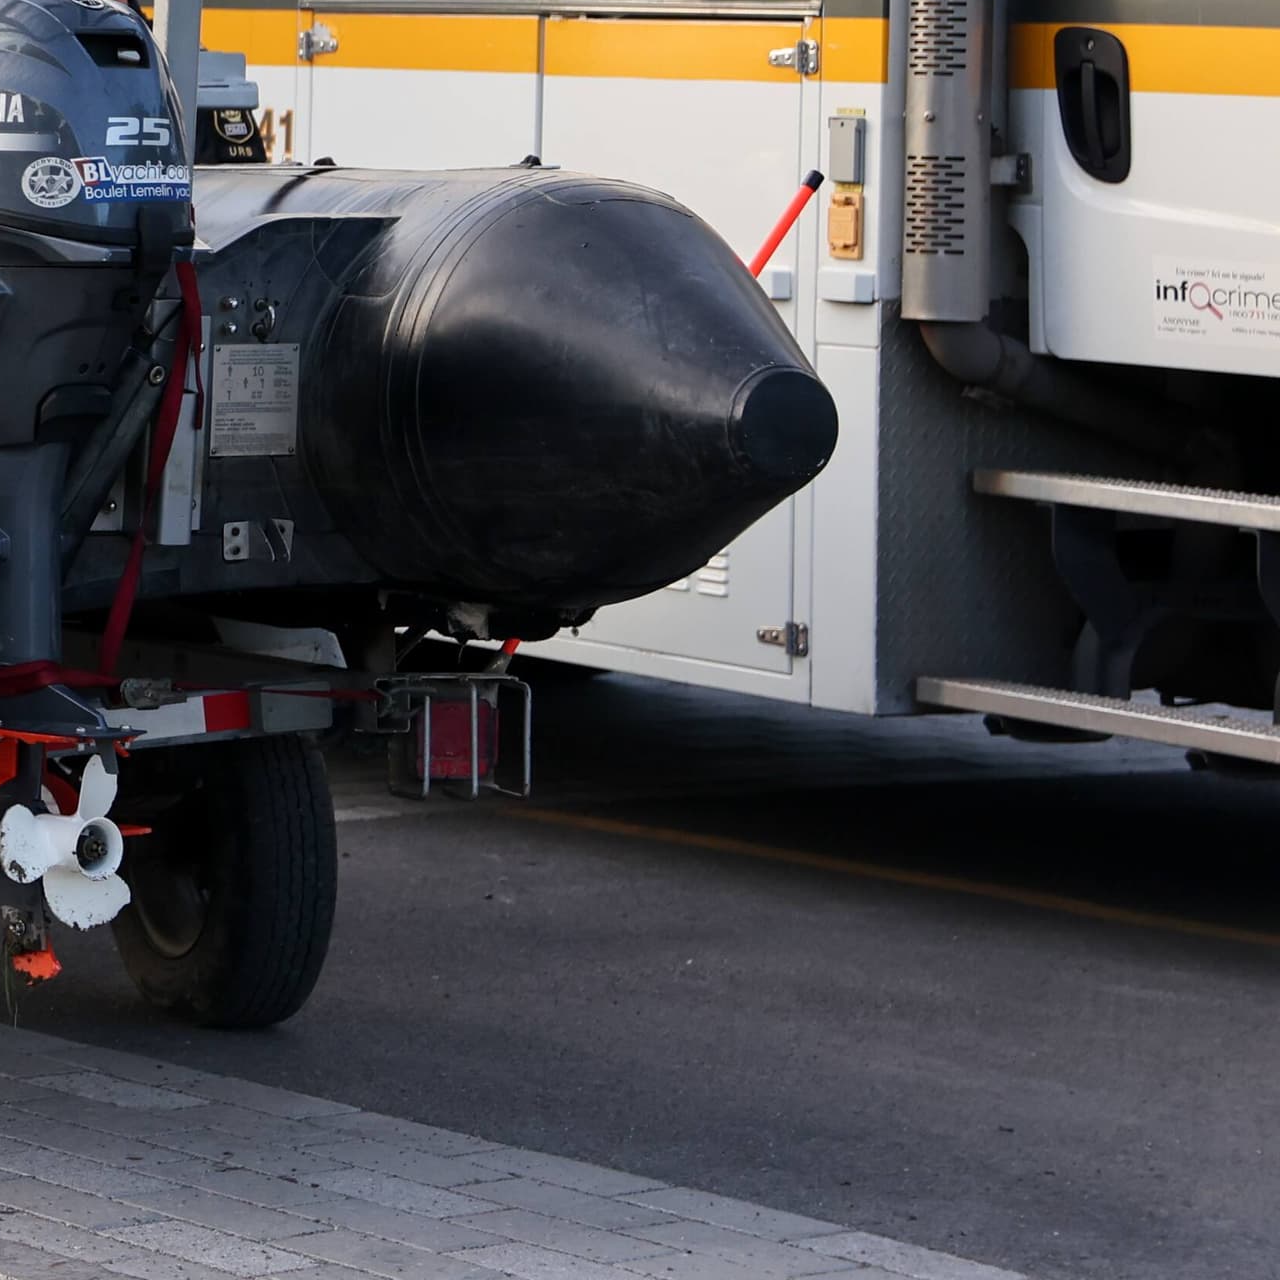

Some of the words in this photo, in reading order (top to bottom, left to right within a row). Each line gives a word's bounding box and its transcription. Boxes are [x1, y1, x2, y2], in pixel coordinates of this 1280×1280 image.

[105, 116, 171, 147] 25
[85, 185, 128, 200] Boulet
[131, 184, 174, 198] Lemelin
